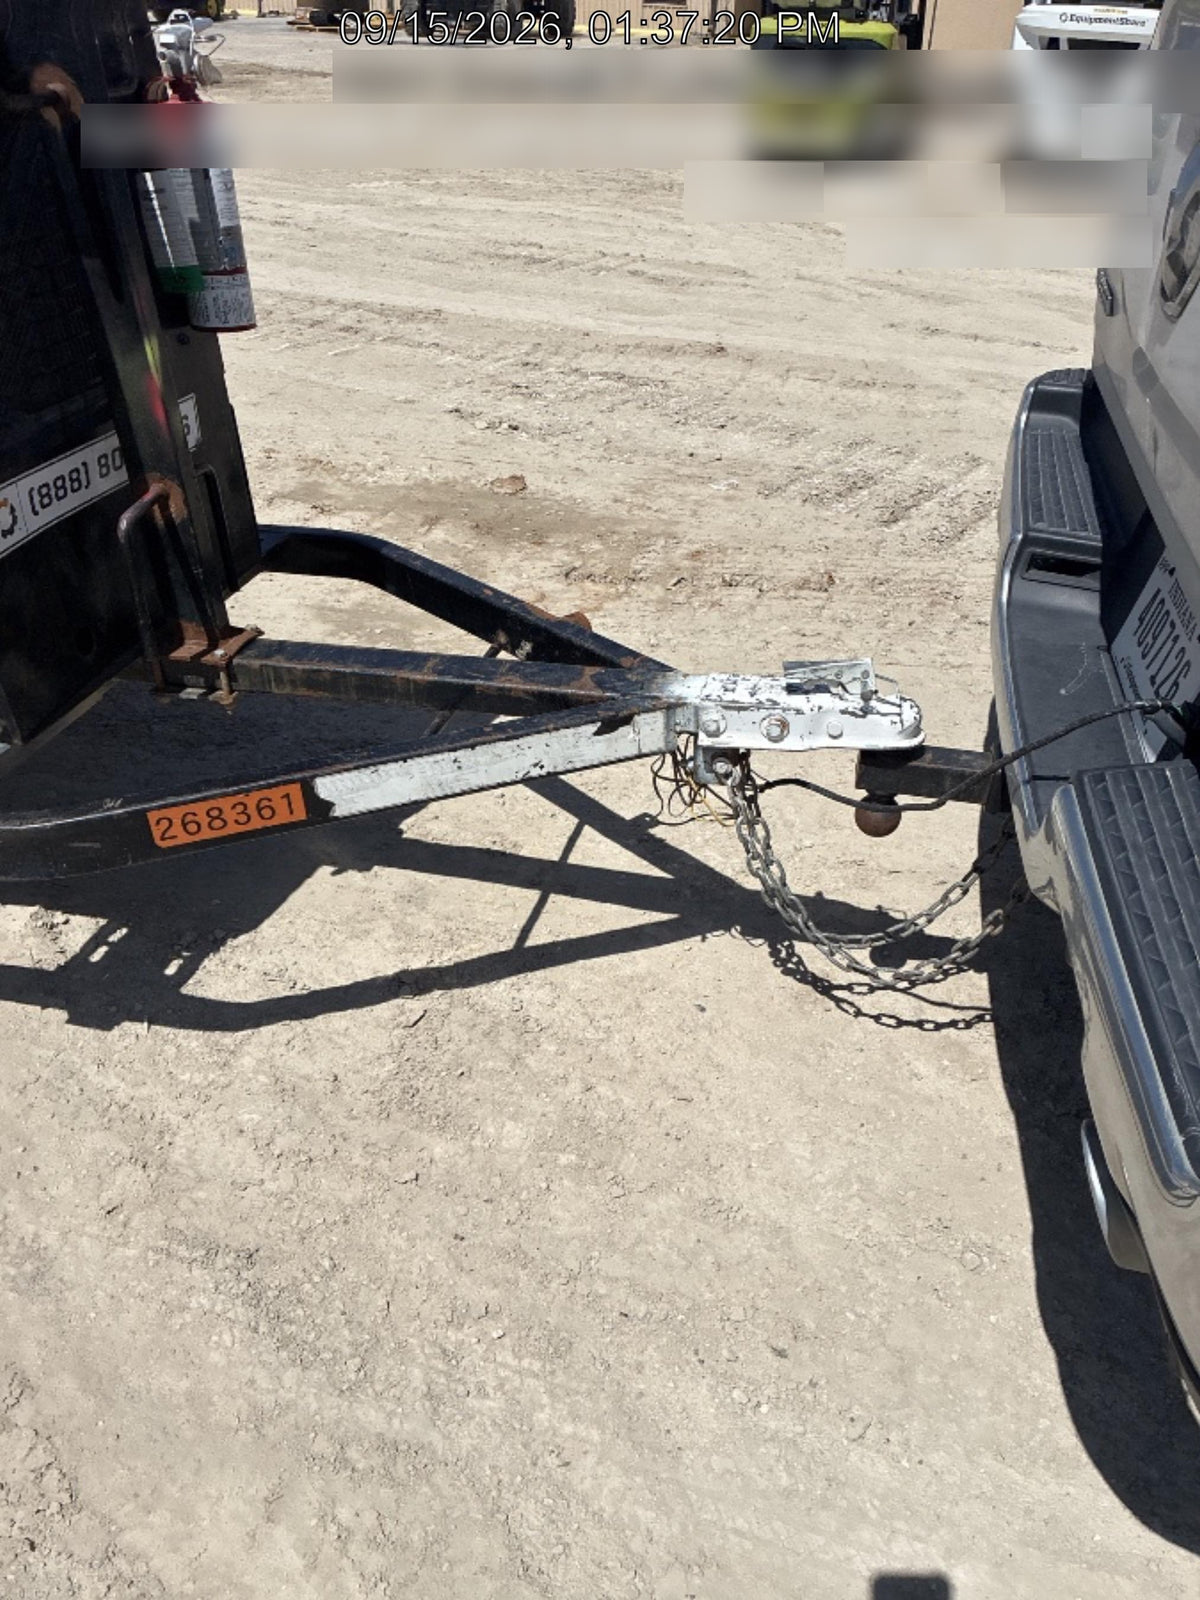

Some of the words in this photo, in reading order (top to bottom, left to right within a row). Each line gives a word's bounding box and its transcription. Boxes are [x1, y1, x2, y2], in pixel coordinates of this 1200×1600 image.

[28, 461, 91, 516] (888)
[1133, 587, 1192, 701] 4097126
[155, 792, 295, 841] 268361
